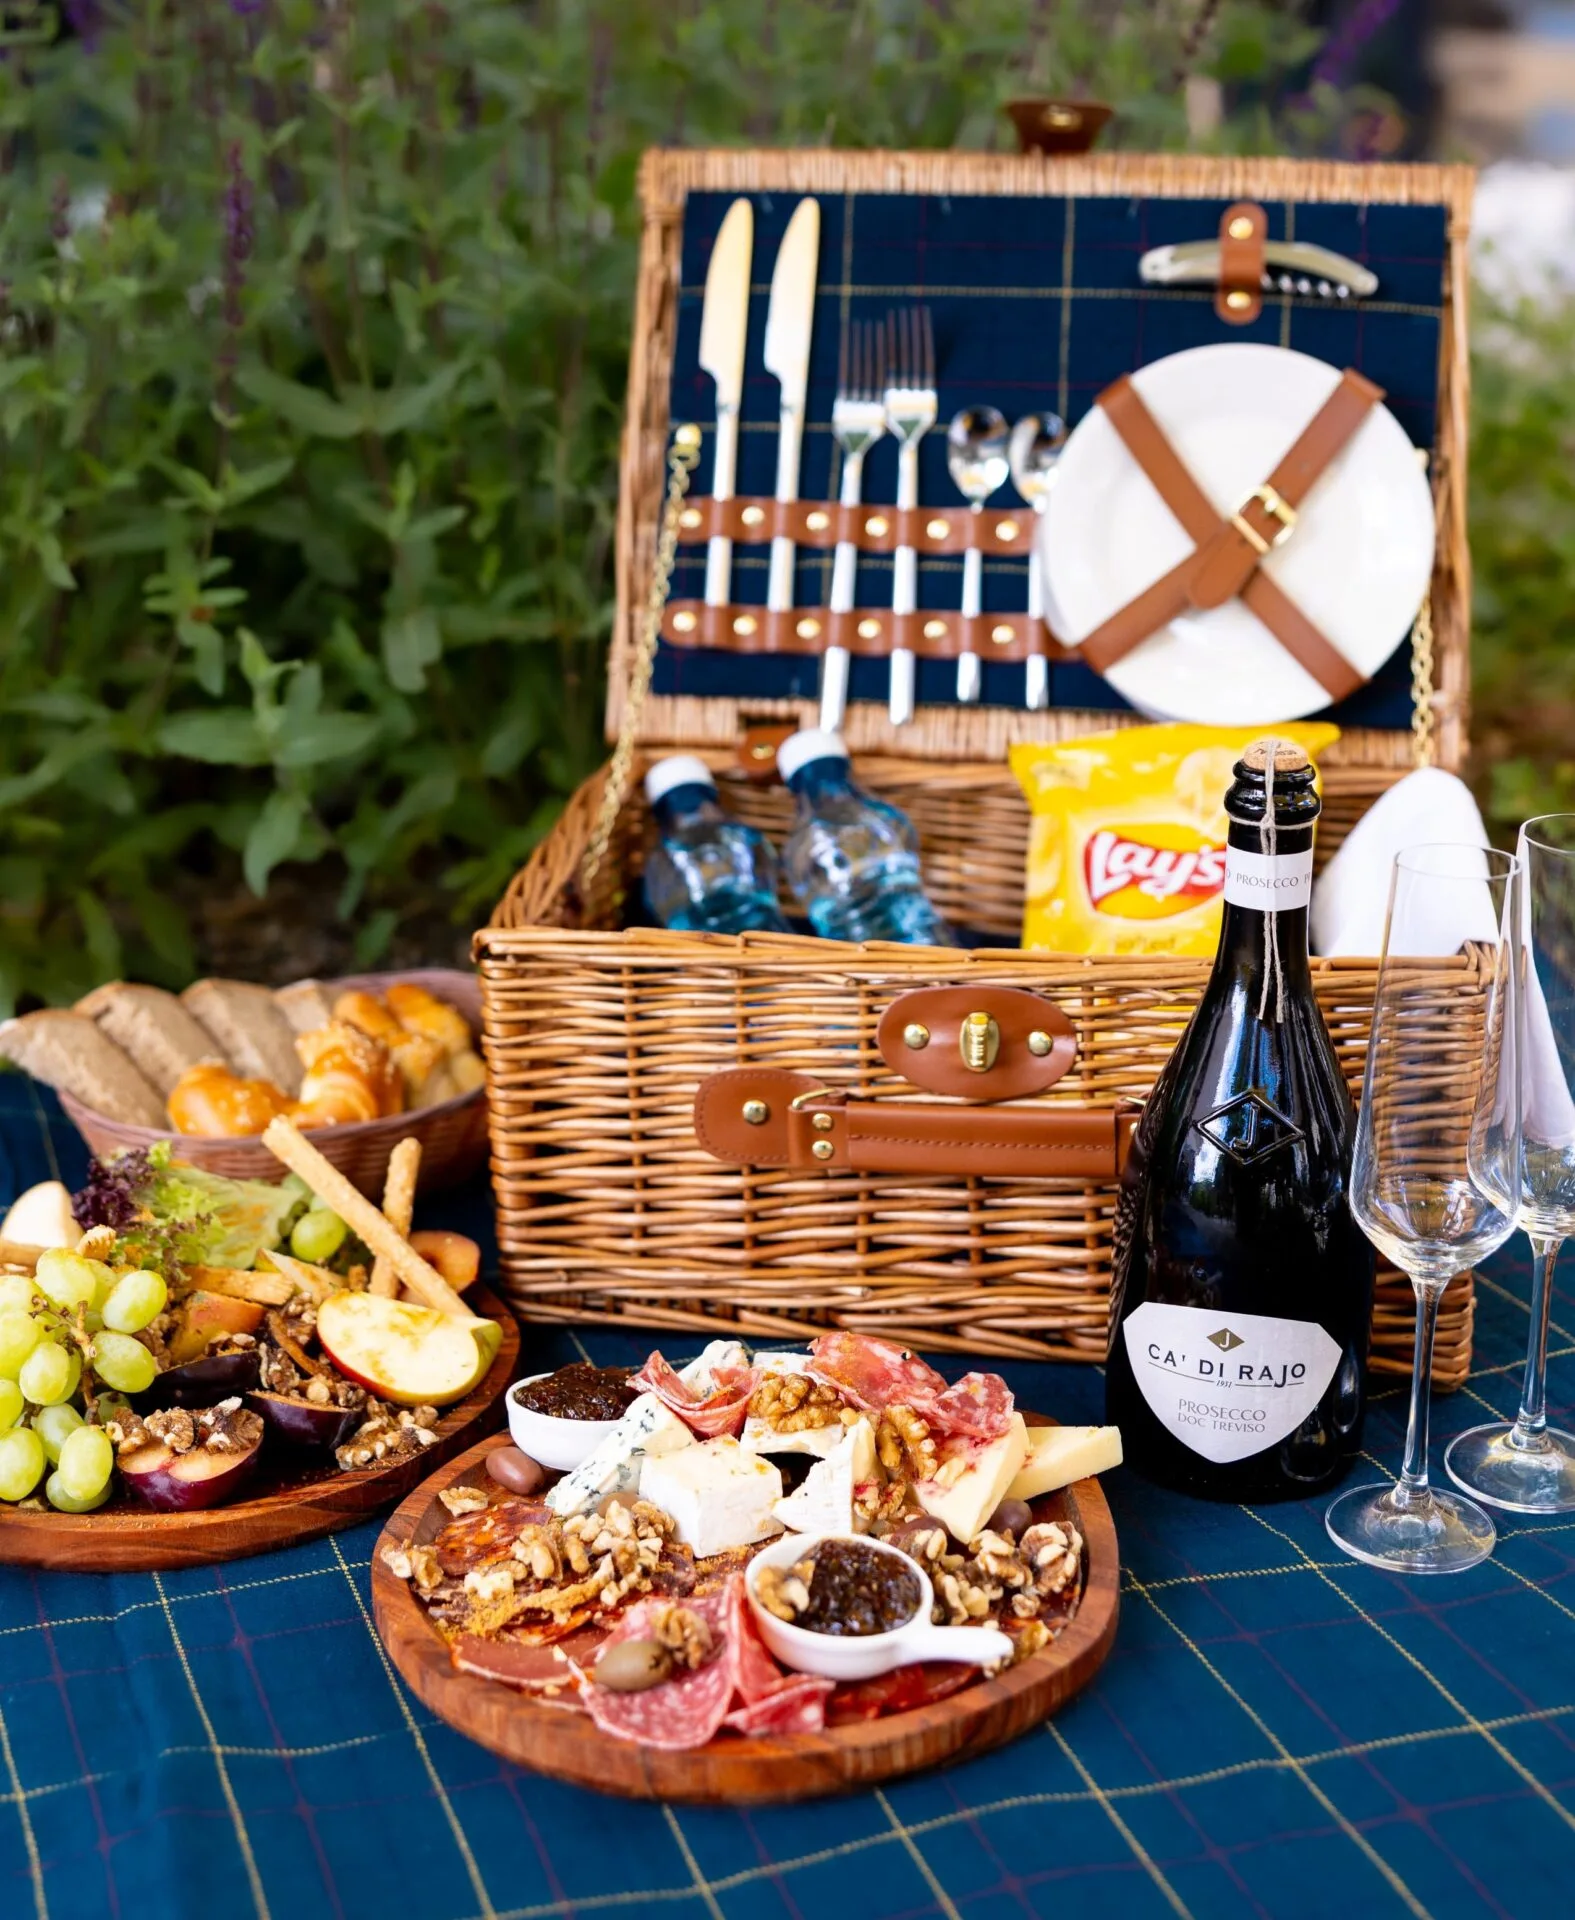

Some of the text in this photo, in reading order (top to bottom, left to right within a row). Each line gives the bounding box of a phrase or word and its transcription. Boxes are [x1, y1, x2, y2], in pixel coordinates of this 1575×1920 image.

[1090, 831, 1226, 900] Lay's
[1236, 872, 1299, 889] PROSECCO
[1220, 1332, 1230, 1348] J
[1148, 1344, 1305, 1388] CA' DI RAJO
[1179, 1399, 1266, 1421] PROSECCO
[1178, 1412, 1265, 1433] DOC TREVISO
